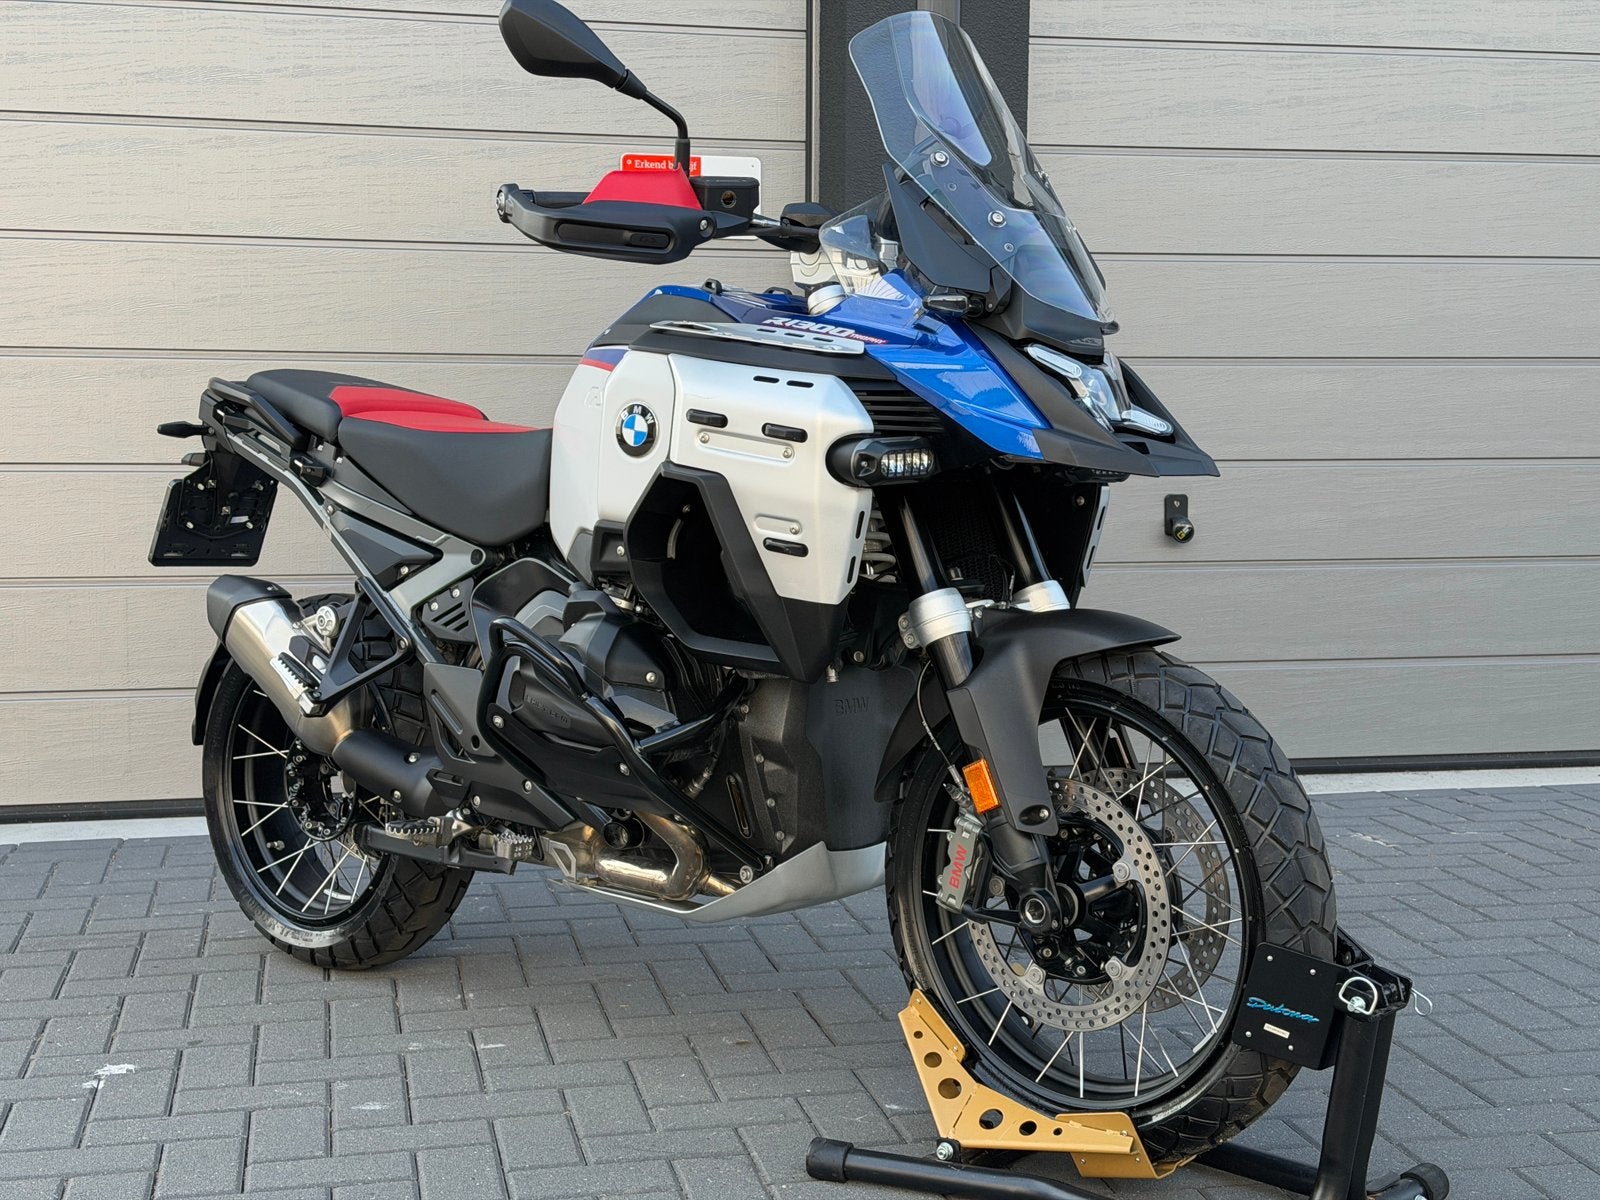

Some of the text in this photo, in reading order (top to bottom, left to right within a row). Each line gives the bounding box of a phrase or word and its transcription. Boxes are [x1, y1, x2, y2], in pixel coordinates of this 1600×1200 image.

[634, 159, 666, 169] Erkend
[850, 333, 887, 345] TROPHY
[620, 404, 655, 425] BMW
[833, 696, 869, 714] BMW
[949, 844, 967, 889] BMW
